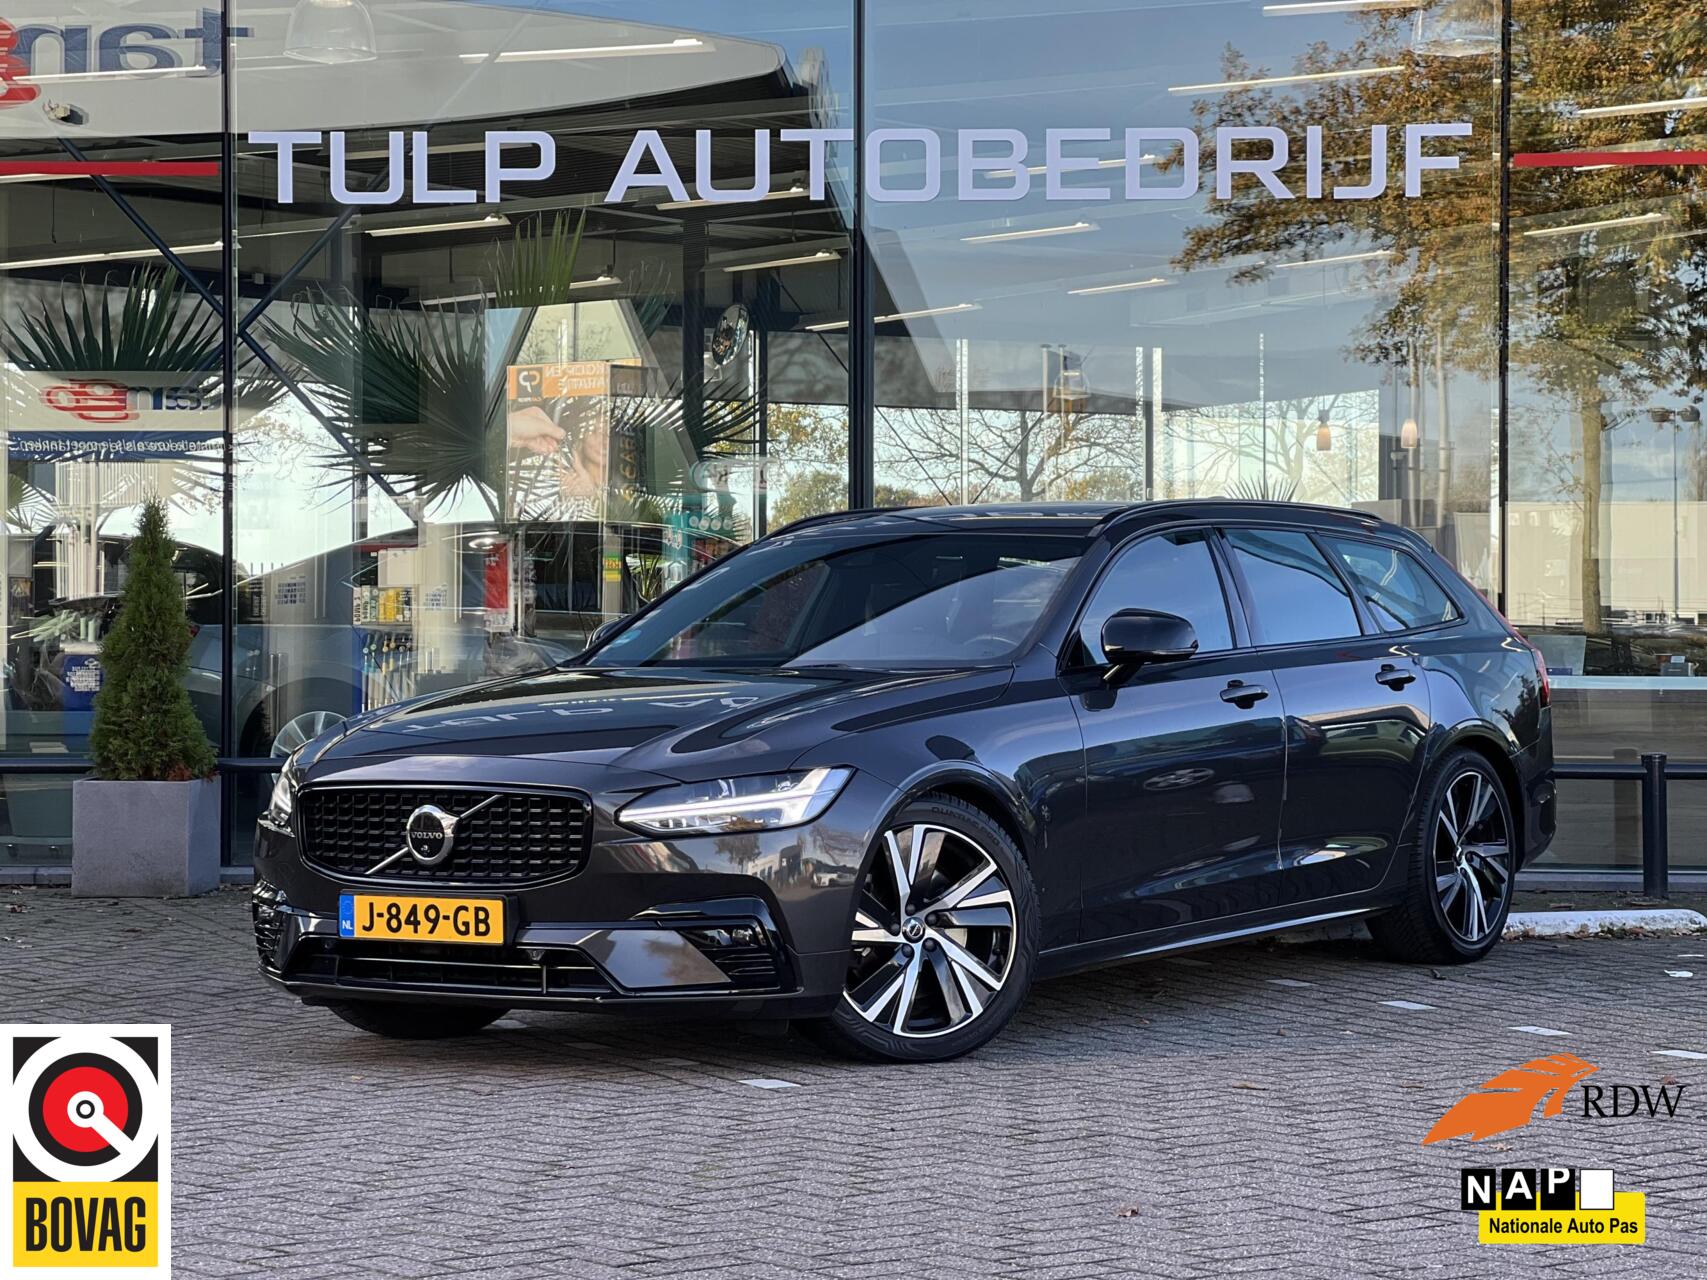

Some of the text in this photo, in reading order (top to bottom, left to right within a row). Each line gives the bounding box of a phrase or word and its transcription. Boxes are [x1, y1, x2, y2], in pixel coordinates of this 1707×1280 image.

[248, 122, 1473, 205] TULP AUTOBEDRIJF
[342, 902, 491, 937] NL J-849-GB
